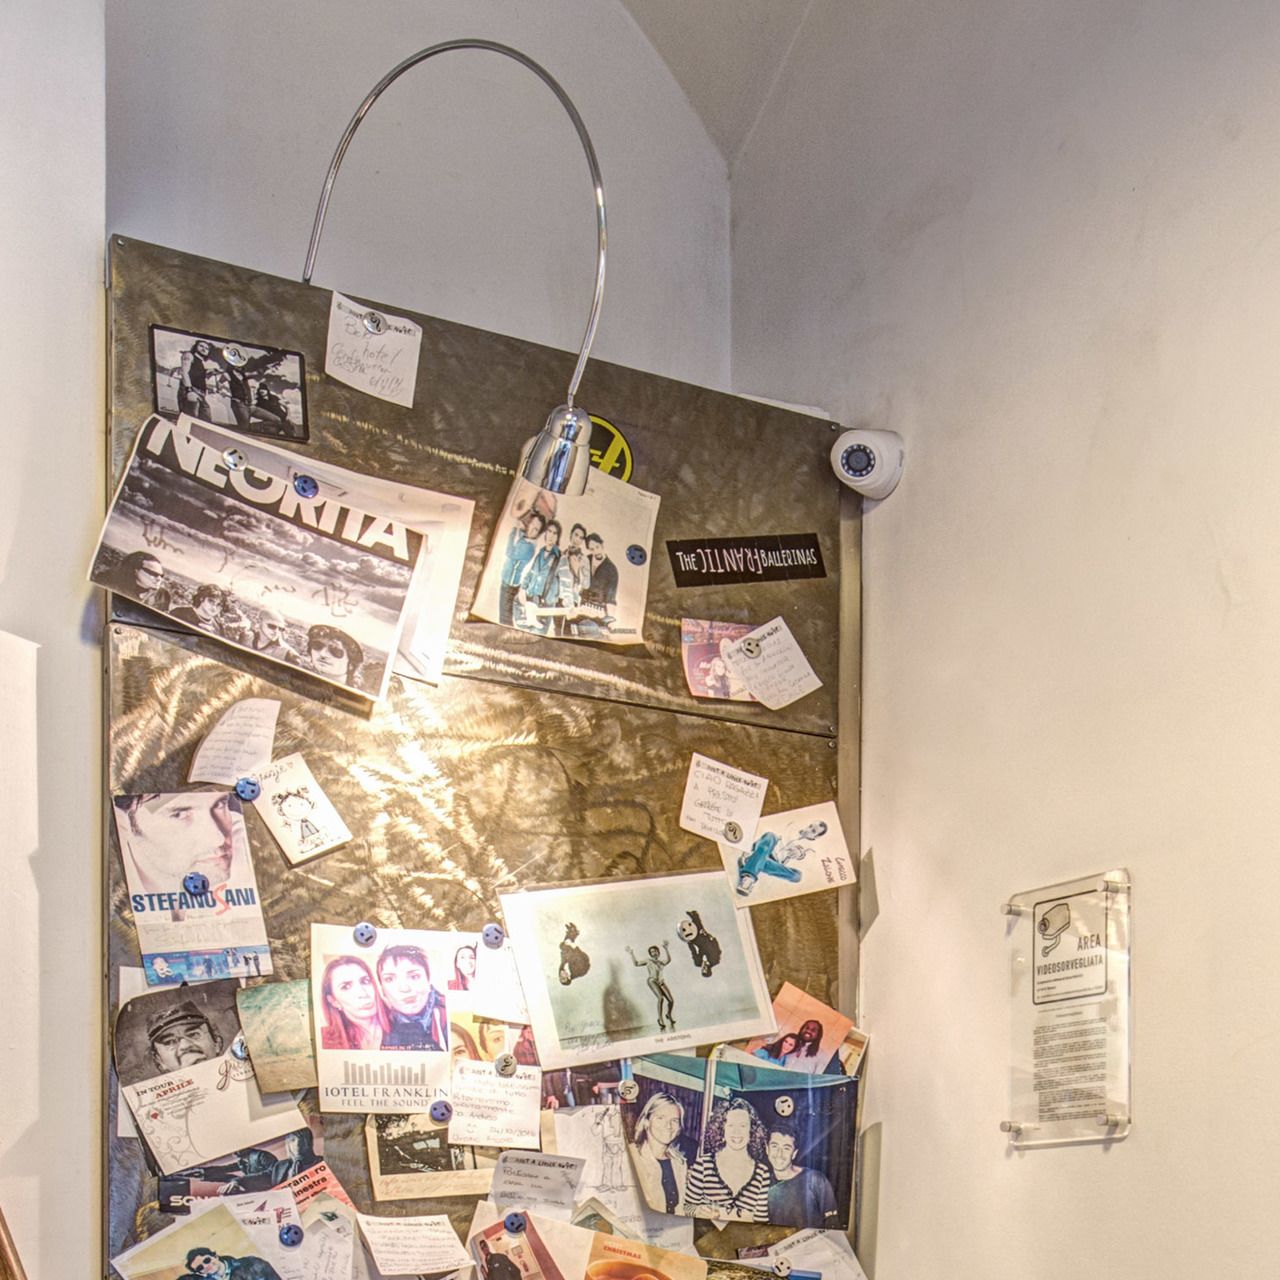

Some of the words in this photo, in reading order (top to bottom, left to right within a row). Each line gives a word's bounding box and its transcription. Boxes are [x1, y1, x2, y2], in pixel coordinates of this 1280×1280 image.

[146, 423, 411, 562] NEGRITA
[761, 548, 818, 567] BALLERINAS
[1077, 933, 1101, 951] AREA
[1036, 954, 1103, 976] VIDEOSORVEGLIATA
[136, 1089, 147, 1097] IN
[148, 1081, 174, 1093] TOUR
[155, 1079, 194, 1099] APRILE
[373, 1087, 448, 1097] FRANKLIN
[342, 1099, 363, 1107] FEEL
[371, 1099, 388, 1107] THE
[393, 1099, 428, 1107] SOUND
[603, 1245, 642, 1260] CHRISTMAS
